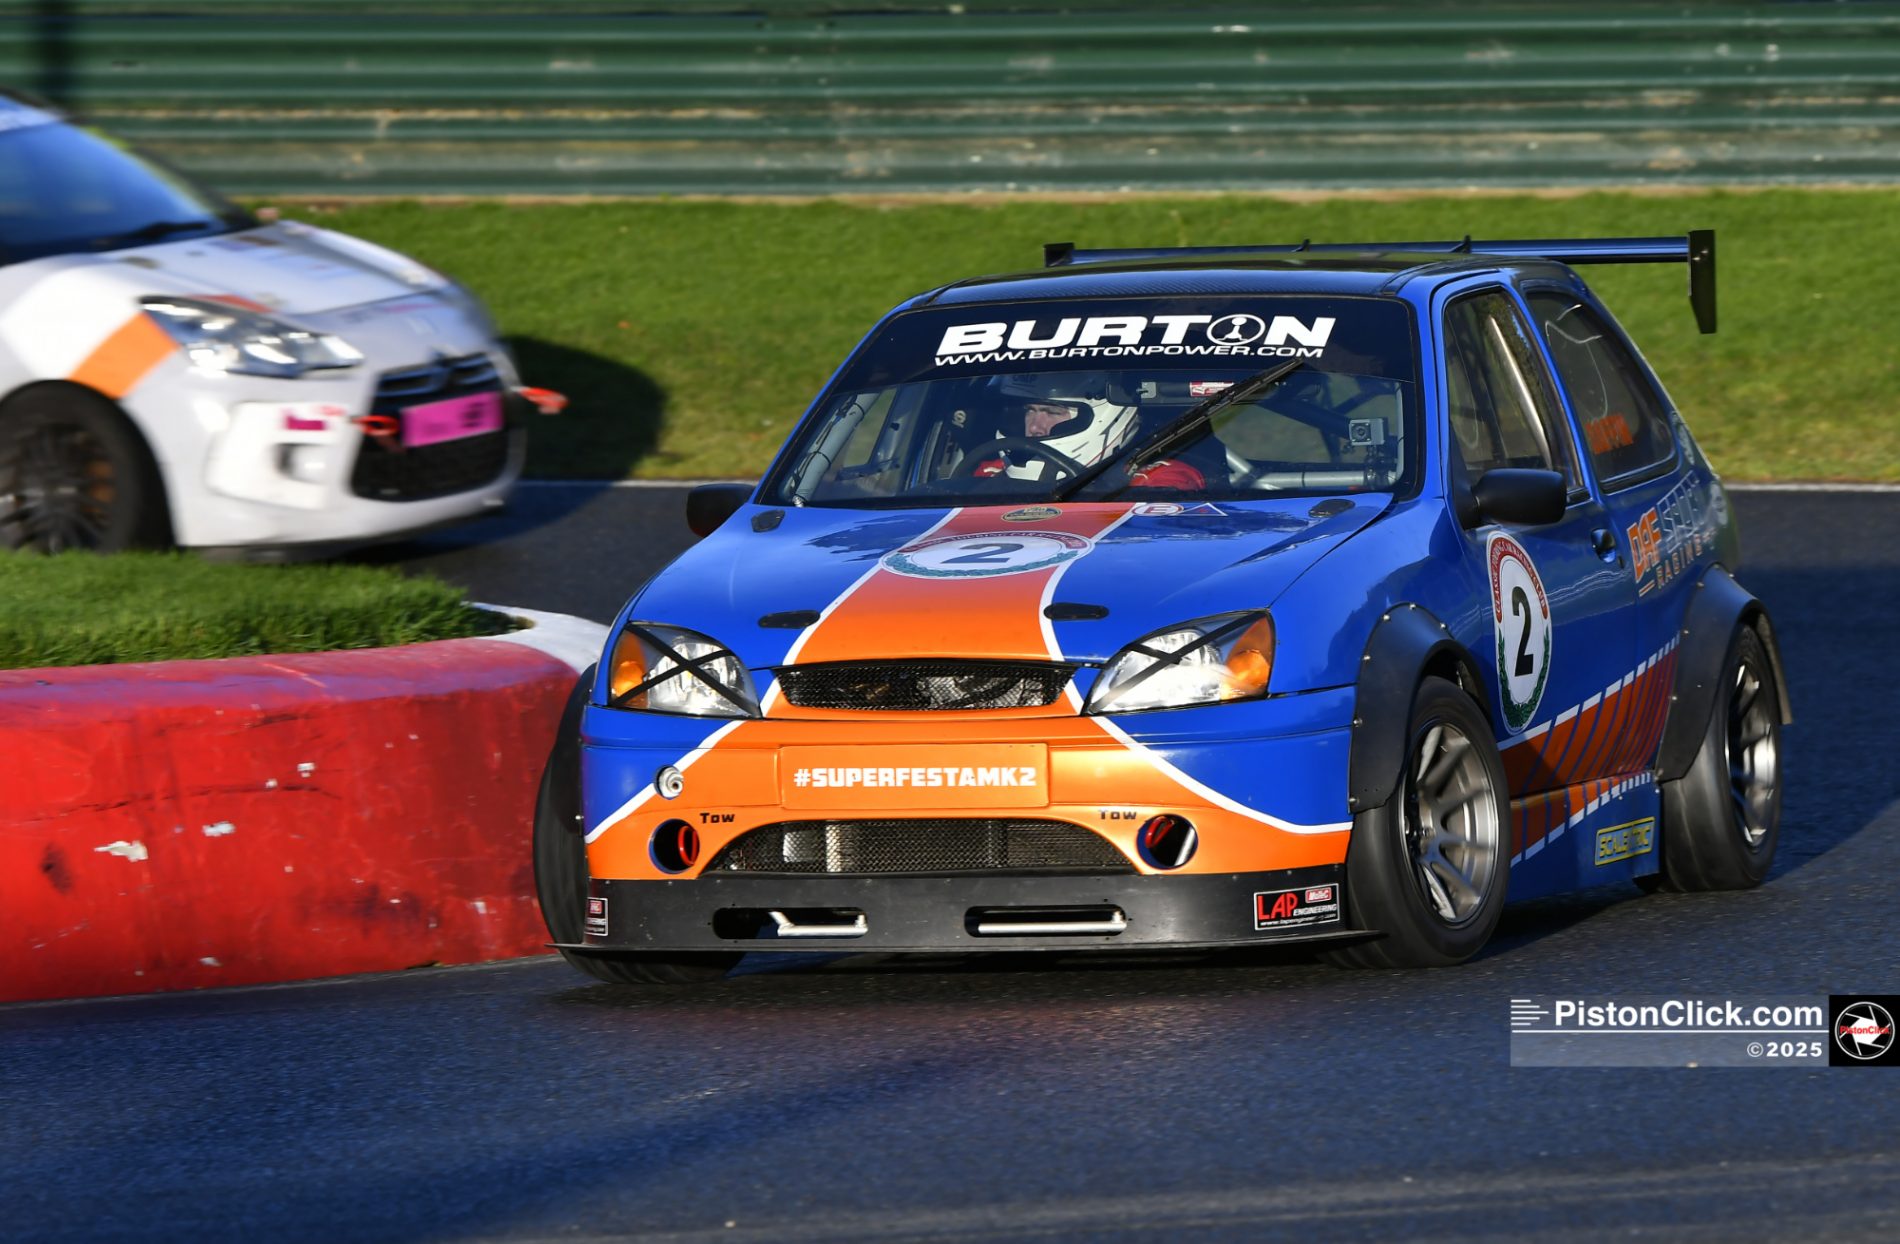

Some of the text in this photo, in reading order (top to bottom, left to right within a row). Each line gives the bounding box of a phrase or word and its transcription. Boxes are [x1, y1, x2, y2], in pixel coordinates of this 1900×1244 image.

[935, 313, 1336, 356] BURTON
[934, 345, 1324, 366] WWW.BURTONPOWER.COM
[939, 542, 1025, 564] 2
[1511, 586, 1534, 677] 2
[794, 767, 1037, 788] #SUPERFESTAMK2
[1257, 892, 1299, 920] LAP
